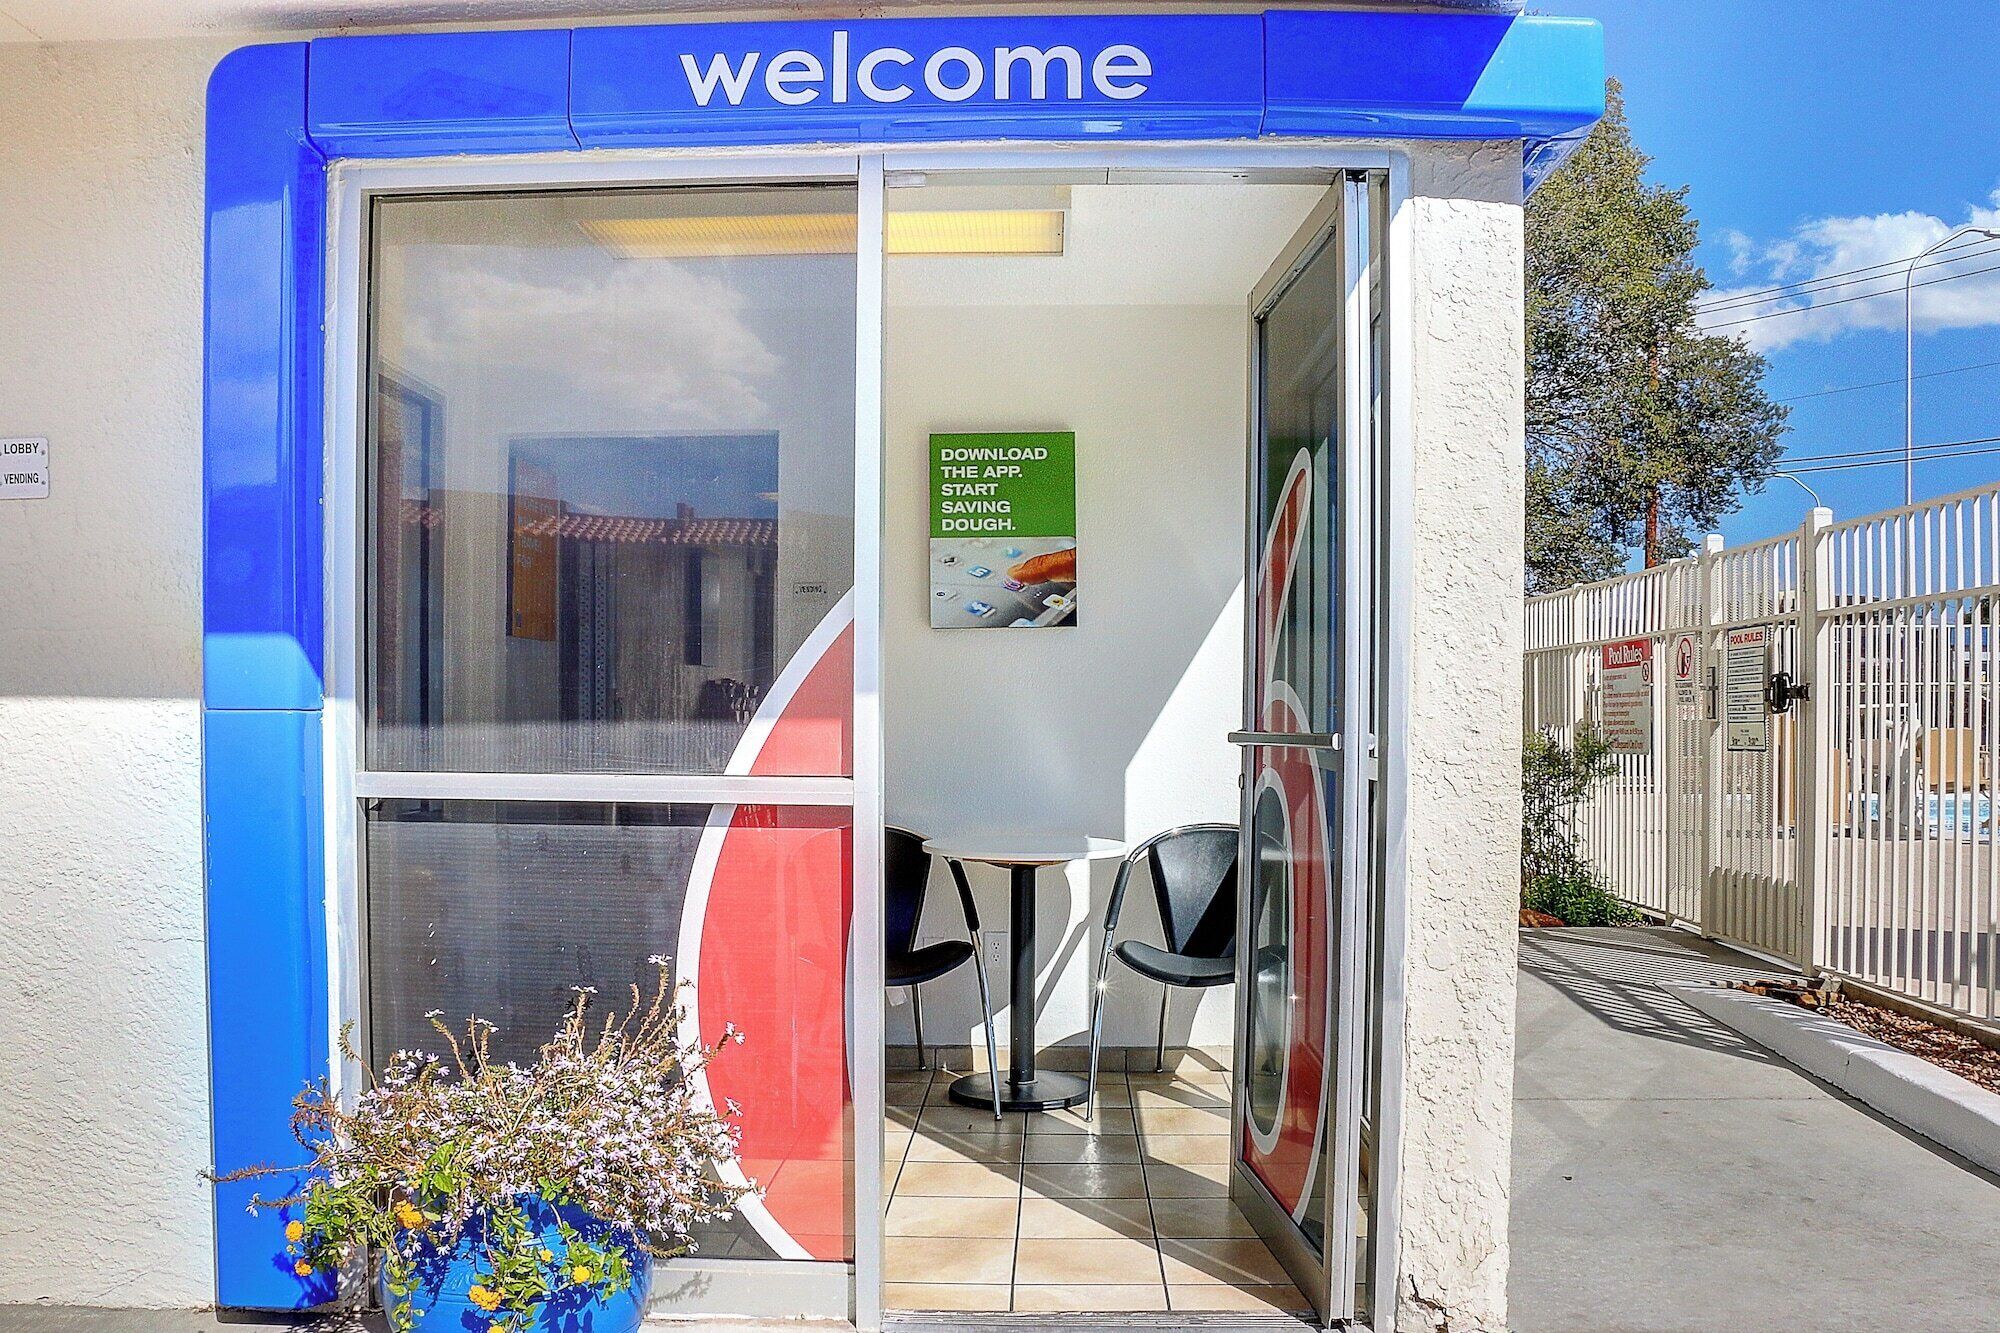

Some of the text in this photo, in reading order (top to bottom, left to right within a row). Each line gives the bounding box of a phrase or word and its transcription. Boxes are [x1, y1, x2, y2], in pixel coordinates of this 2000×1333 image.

[679, 30, 1152, 106] welcome
[4, 443, 39, 454] LOBBY
[941, 447, 1048, 461] DOWNLOAD
[4, 472, 39, 484] VENDING
[941, 465, 1023, 479] THE APP.
[941, 483, 998, 496] START
[941, 500, 1011, 514] SAVING
[941, 518, 1016, 531] DOUGH.
[1730, 631, 1763, 645] POOL RULES
[1608, 644, 1643, 665] Pool Rules
